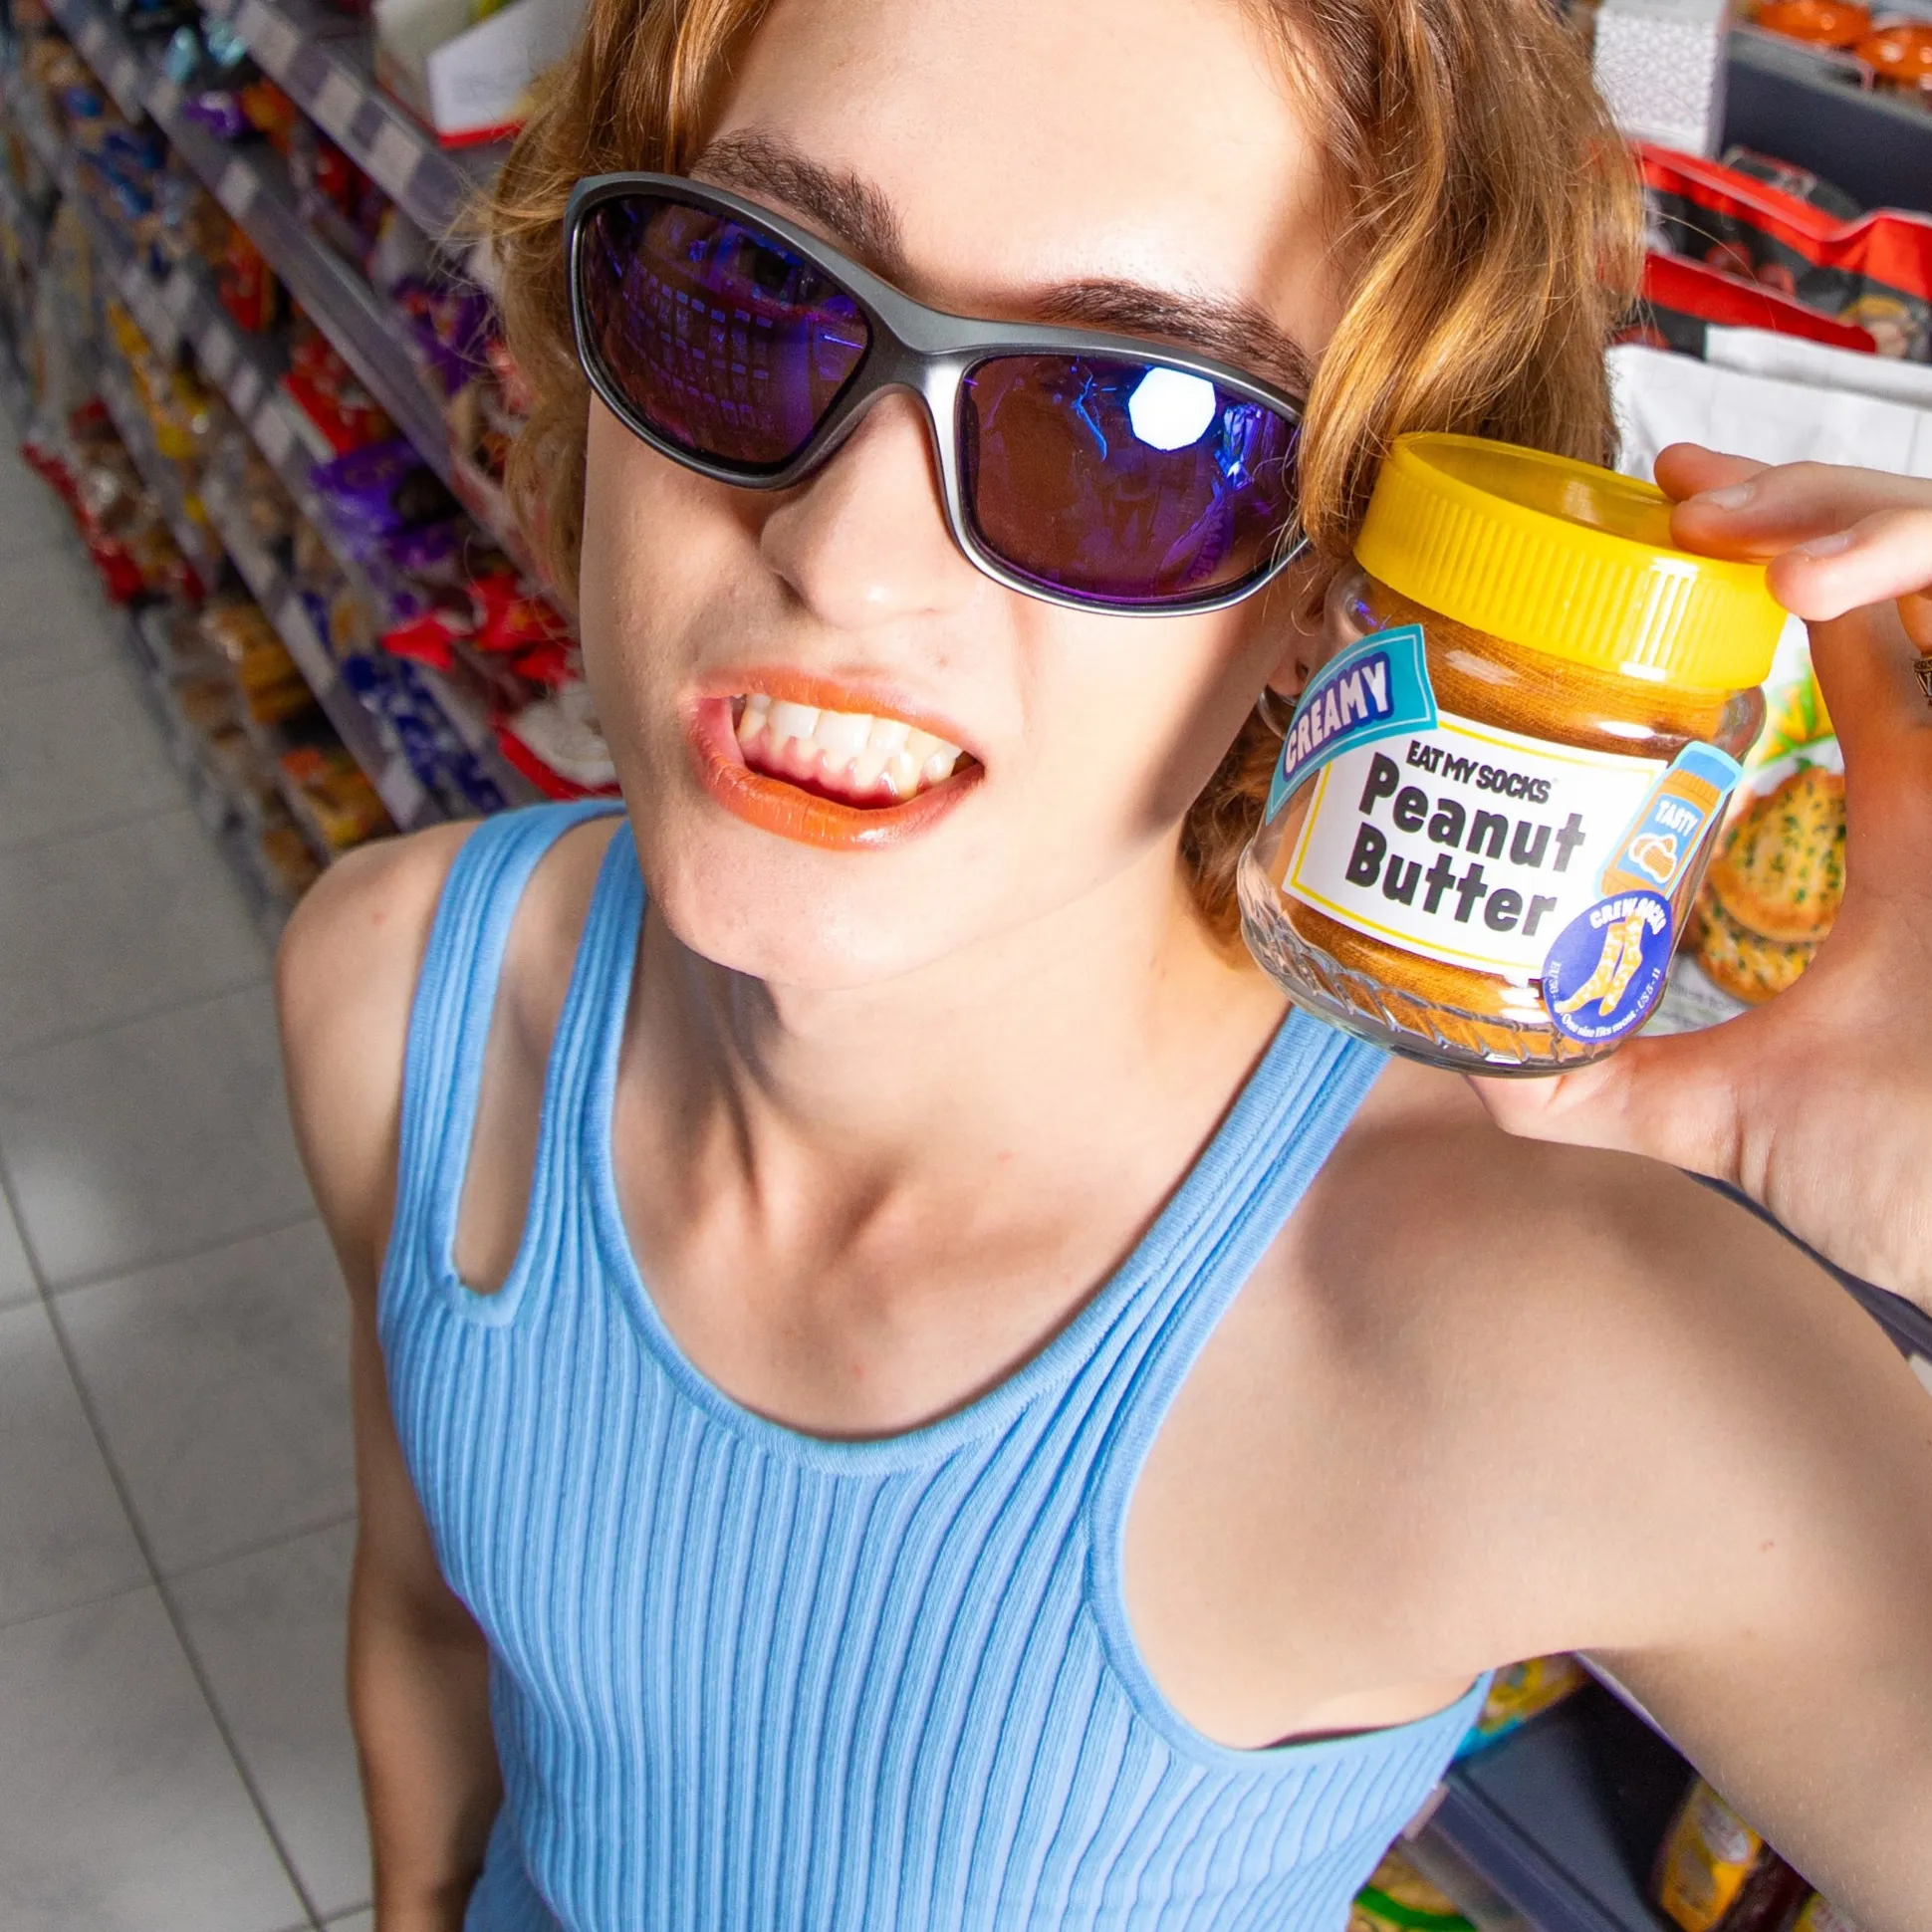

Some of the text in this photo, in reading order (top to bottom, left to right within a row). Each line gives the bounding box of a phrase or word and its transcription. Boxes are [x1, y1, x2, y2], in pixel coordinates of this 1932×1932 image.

[1285, 660, 1388, 775] CREAMY
[1405, 739, 1552, 805] EAT MY SOCKS
[1358, 751, 1586, 873] Peanut
[1654, 800, 1699, 838] TASTY
[1344, 821, 1559, 937] Butter
[1589, 896, 1667, 936] CREW SOCKS
[1576, 1025, 1595, 1039] size
[1594, 1026, 1613, 1039] fits
